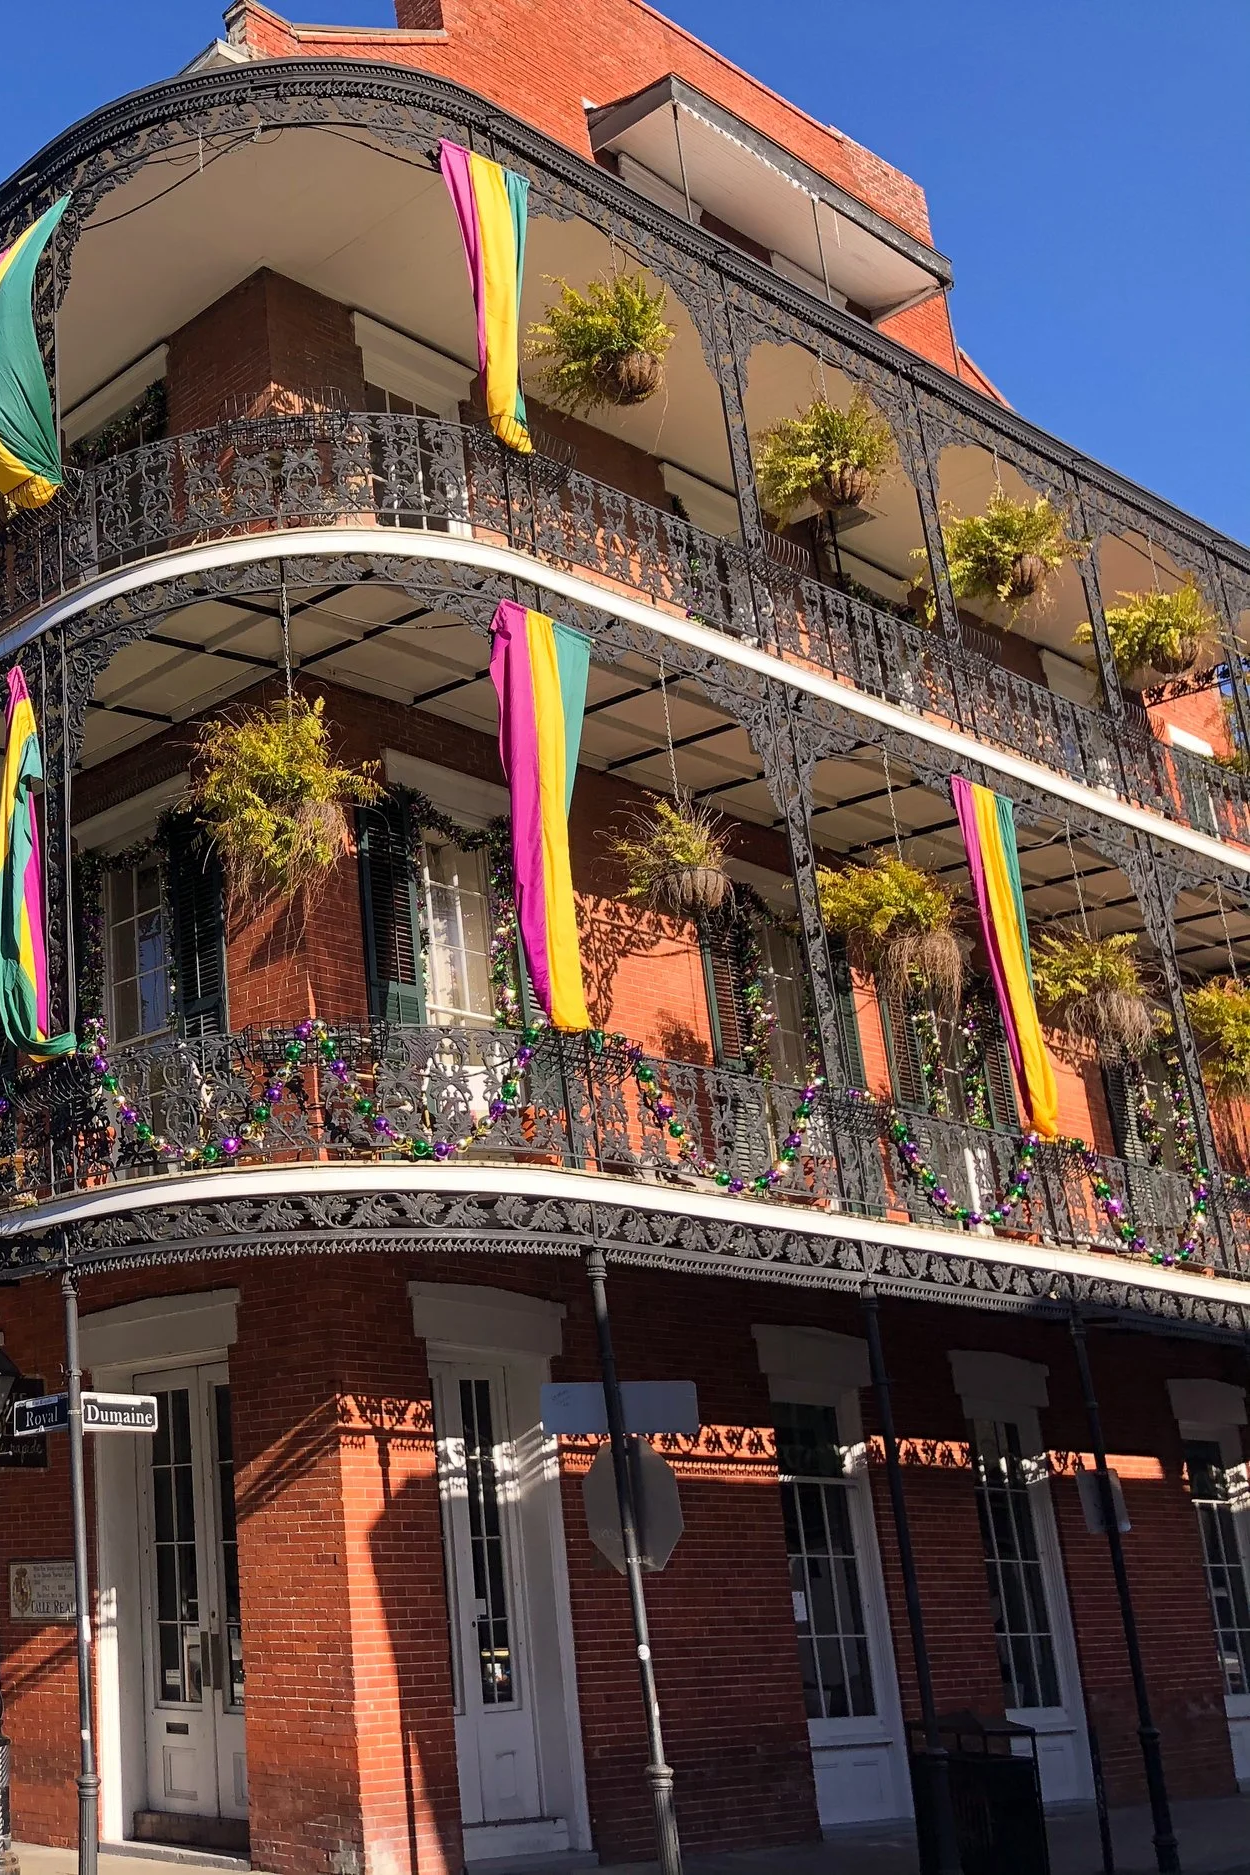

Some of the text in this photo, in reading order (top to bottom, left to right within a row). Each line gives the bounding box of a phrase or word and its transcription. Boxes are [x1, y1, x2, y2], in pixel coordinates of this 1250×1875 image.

[25, 1405, 58, 1428] Royal
[86, 1404, 153, 1424] Dumaine
[31, 1599, 76, 1614] CALLE REAL
